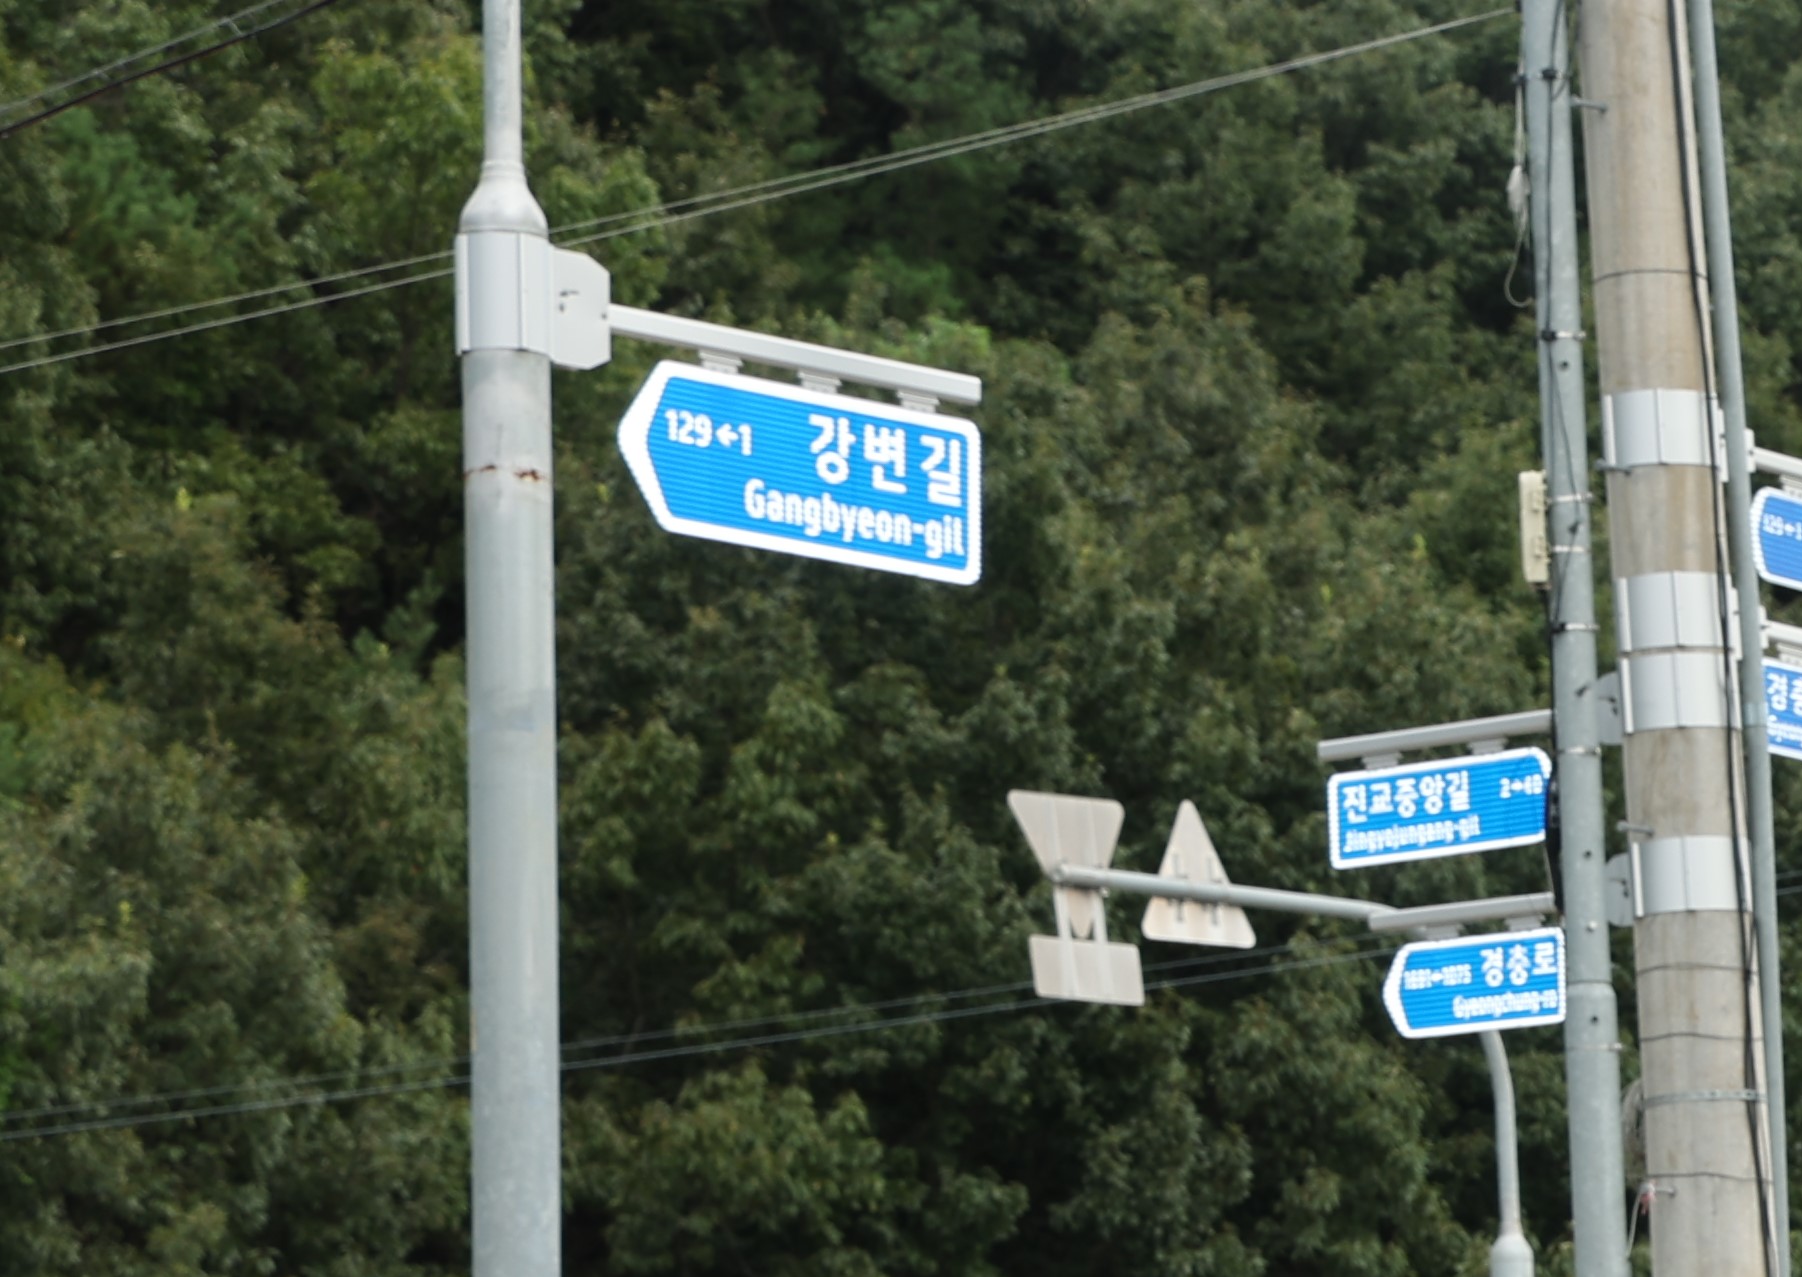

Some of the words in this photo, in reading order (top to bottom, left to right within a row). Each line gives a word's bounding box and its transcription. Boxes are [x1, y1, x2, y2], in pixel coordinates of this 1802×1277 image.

[808, 412, 962, 508] 강변길
[743, 477, 966, 560] Gangbyeon-gil
[1342, 769, 1471, 824] 진교중앙길
[1480, 942, 1557, 987] 경충로
